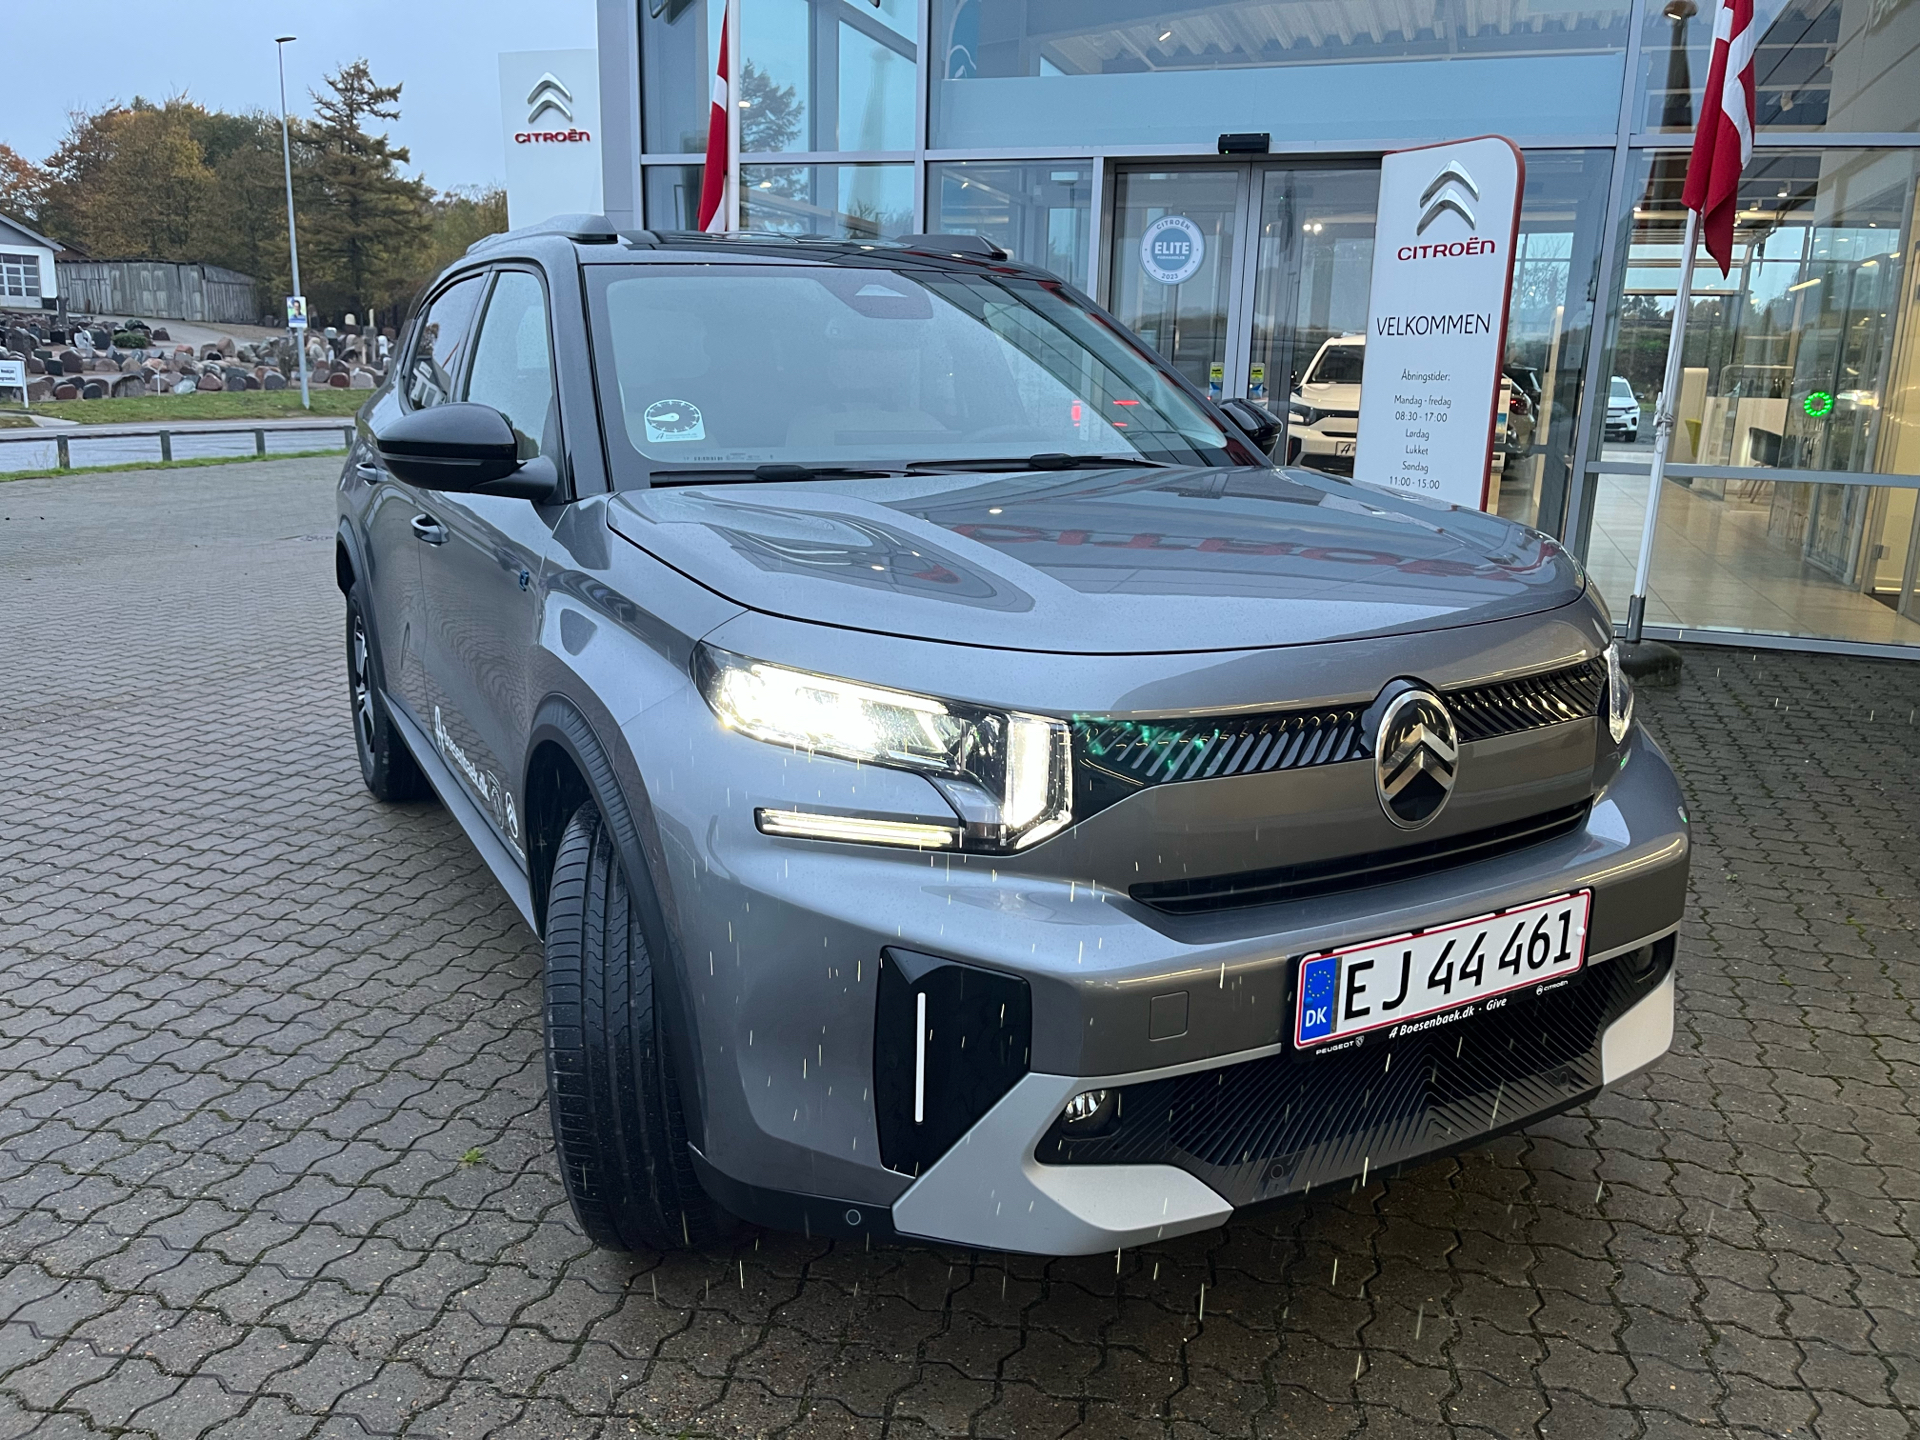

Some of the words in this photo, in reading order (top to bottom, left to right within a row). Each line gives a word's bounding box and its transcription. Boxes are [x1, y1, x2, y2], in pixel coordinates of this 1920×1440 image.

[514, 128, 591, 144] CITROËN
[1156, 219, 1191, 230] CITROËN
[1154, 242, 1190, 254] ELITE
[1397, 237, 1496, 261] CITROËN
[1376, 313, 1491, 336] VELKOMMEN
[1401, 368, 1451, 384] Åbningstider:
[1394, 395, 1422, 408] Mandag
[1428, 395, 1452, 409] fredag
[1395, 411, 1418, 421] 08:30
[1424, 412, 1448, 422] 17:00
[1405, 428, 1430, 441] Lørdag
[1405, 445, 1429, 455] Lukket
[1389, 475, 1411, 487] 11:00
[1417, 479, 1441, 490] 15:00
[1344, 950, 1412, 1021] EJ
[1427, 930, 1487, 996] 44
[1498, 908, 1572, 976] 461
[1304, 1006, 1327, 1028] DK
[1399, 1005, 1475, 1036] Boesenbaek.dk
[1486, 998, 1508, 1011] Give
[1315, 1040, 1355, 1056] PEUGEOT
